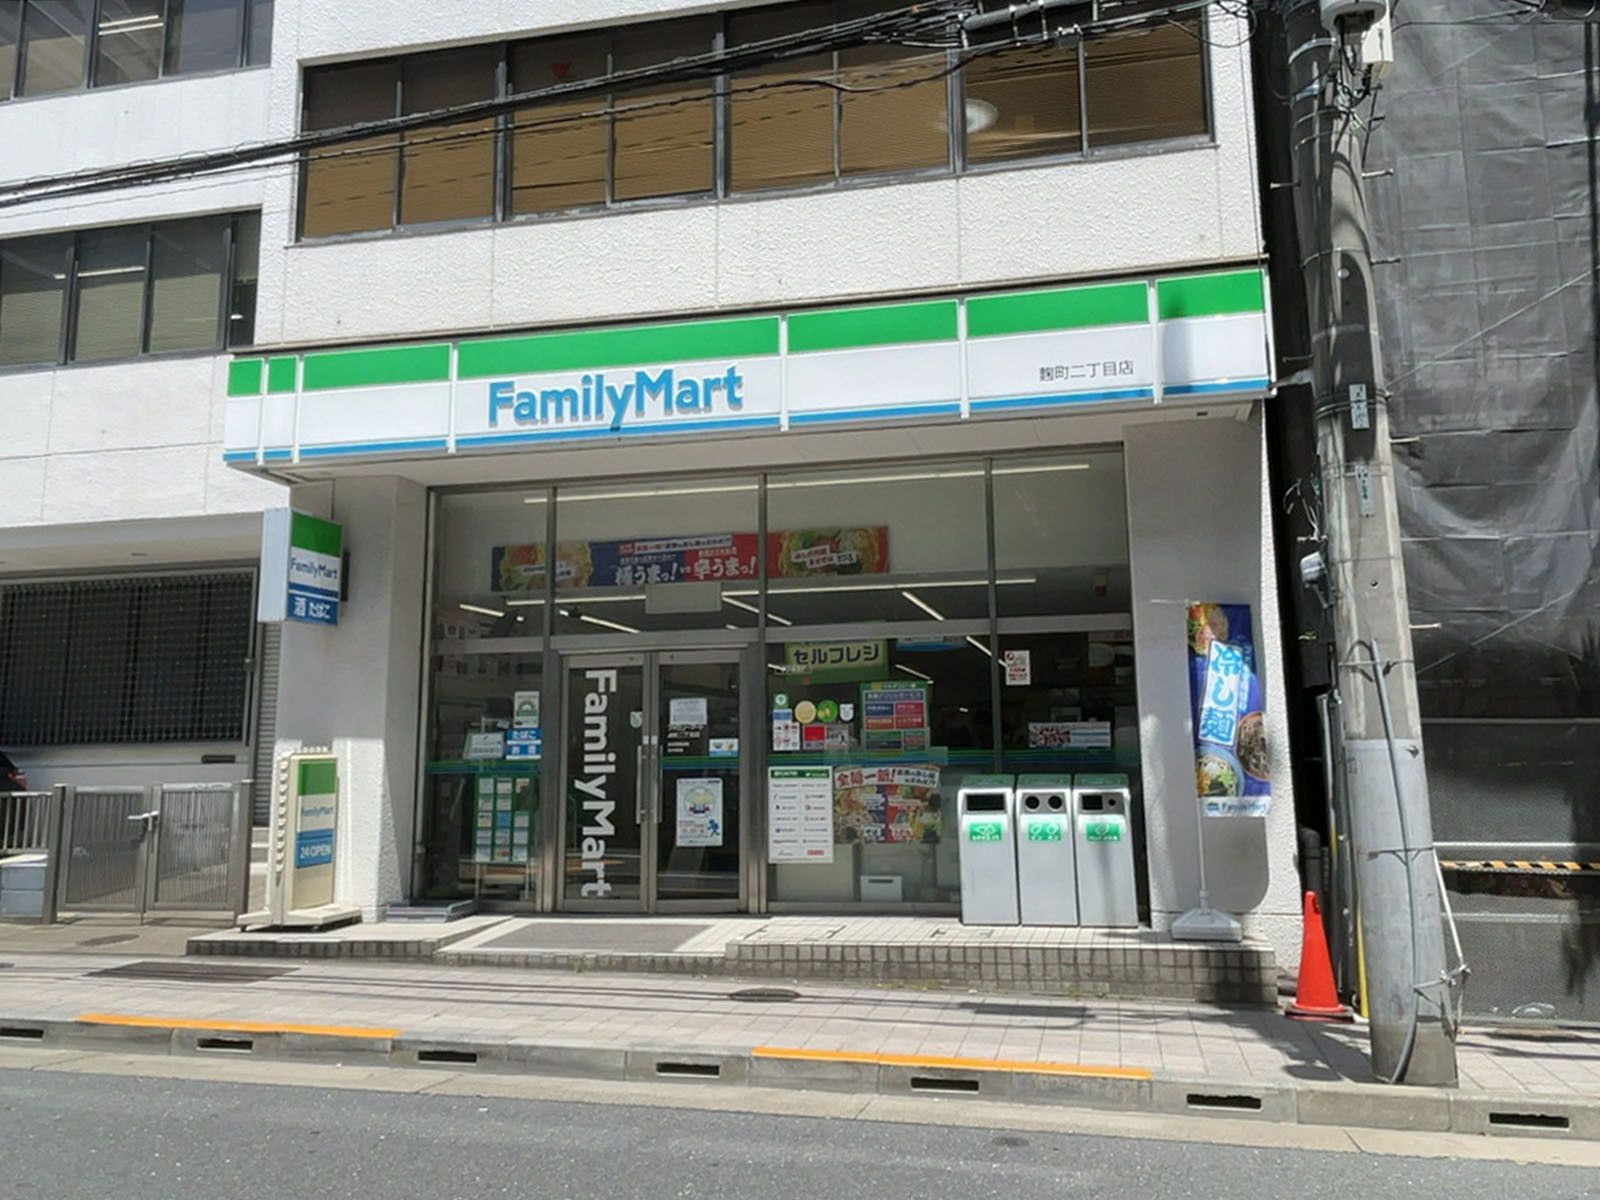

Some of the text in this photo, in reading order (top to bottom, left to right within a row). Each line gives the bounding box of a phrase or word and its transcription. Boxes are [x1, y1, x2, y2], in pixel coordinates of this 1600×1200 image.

[488, 365, 744, 431] FamilyMart
[291, 558, 338, 579] FamilyMart
[794, 643, 880, 665] セルフレジ
[1200, 641, 1244, 744] 冷し麺
[574, 669, 617, 897] FamilyMart
